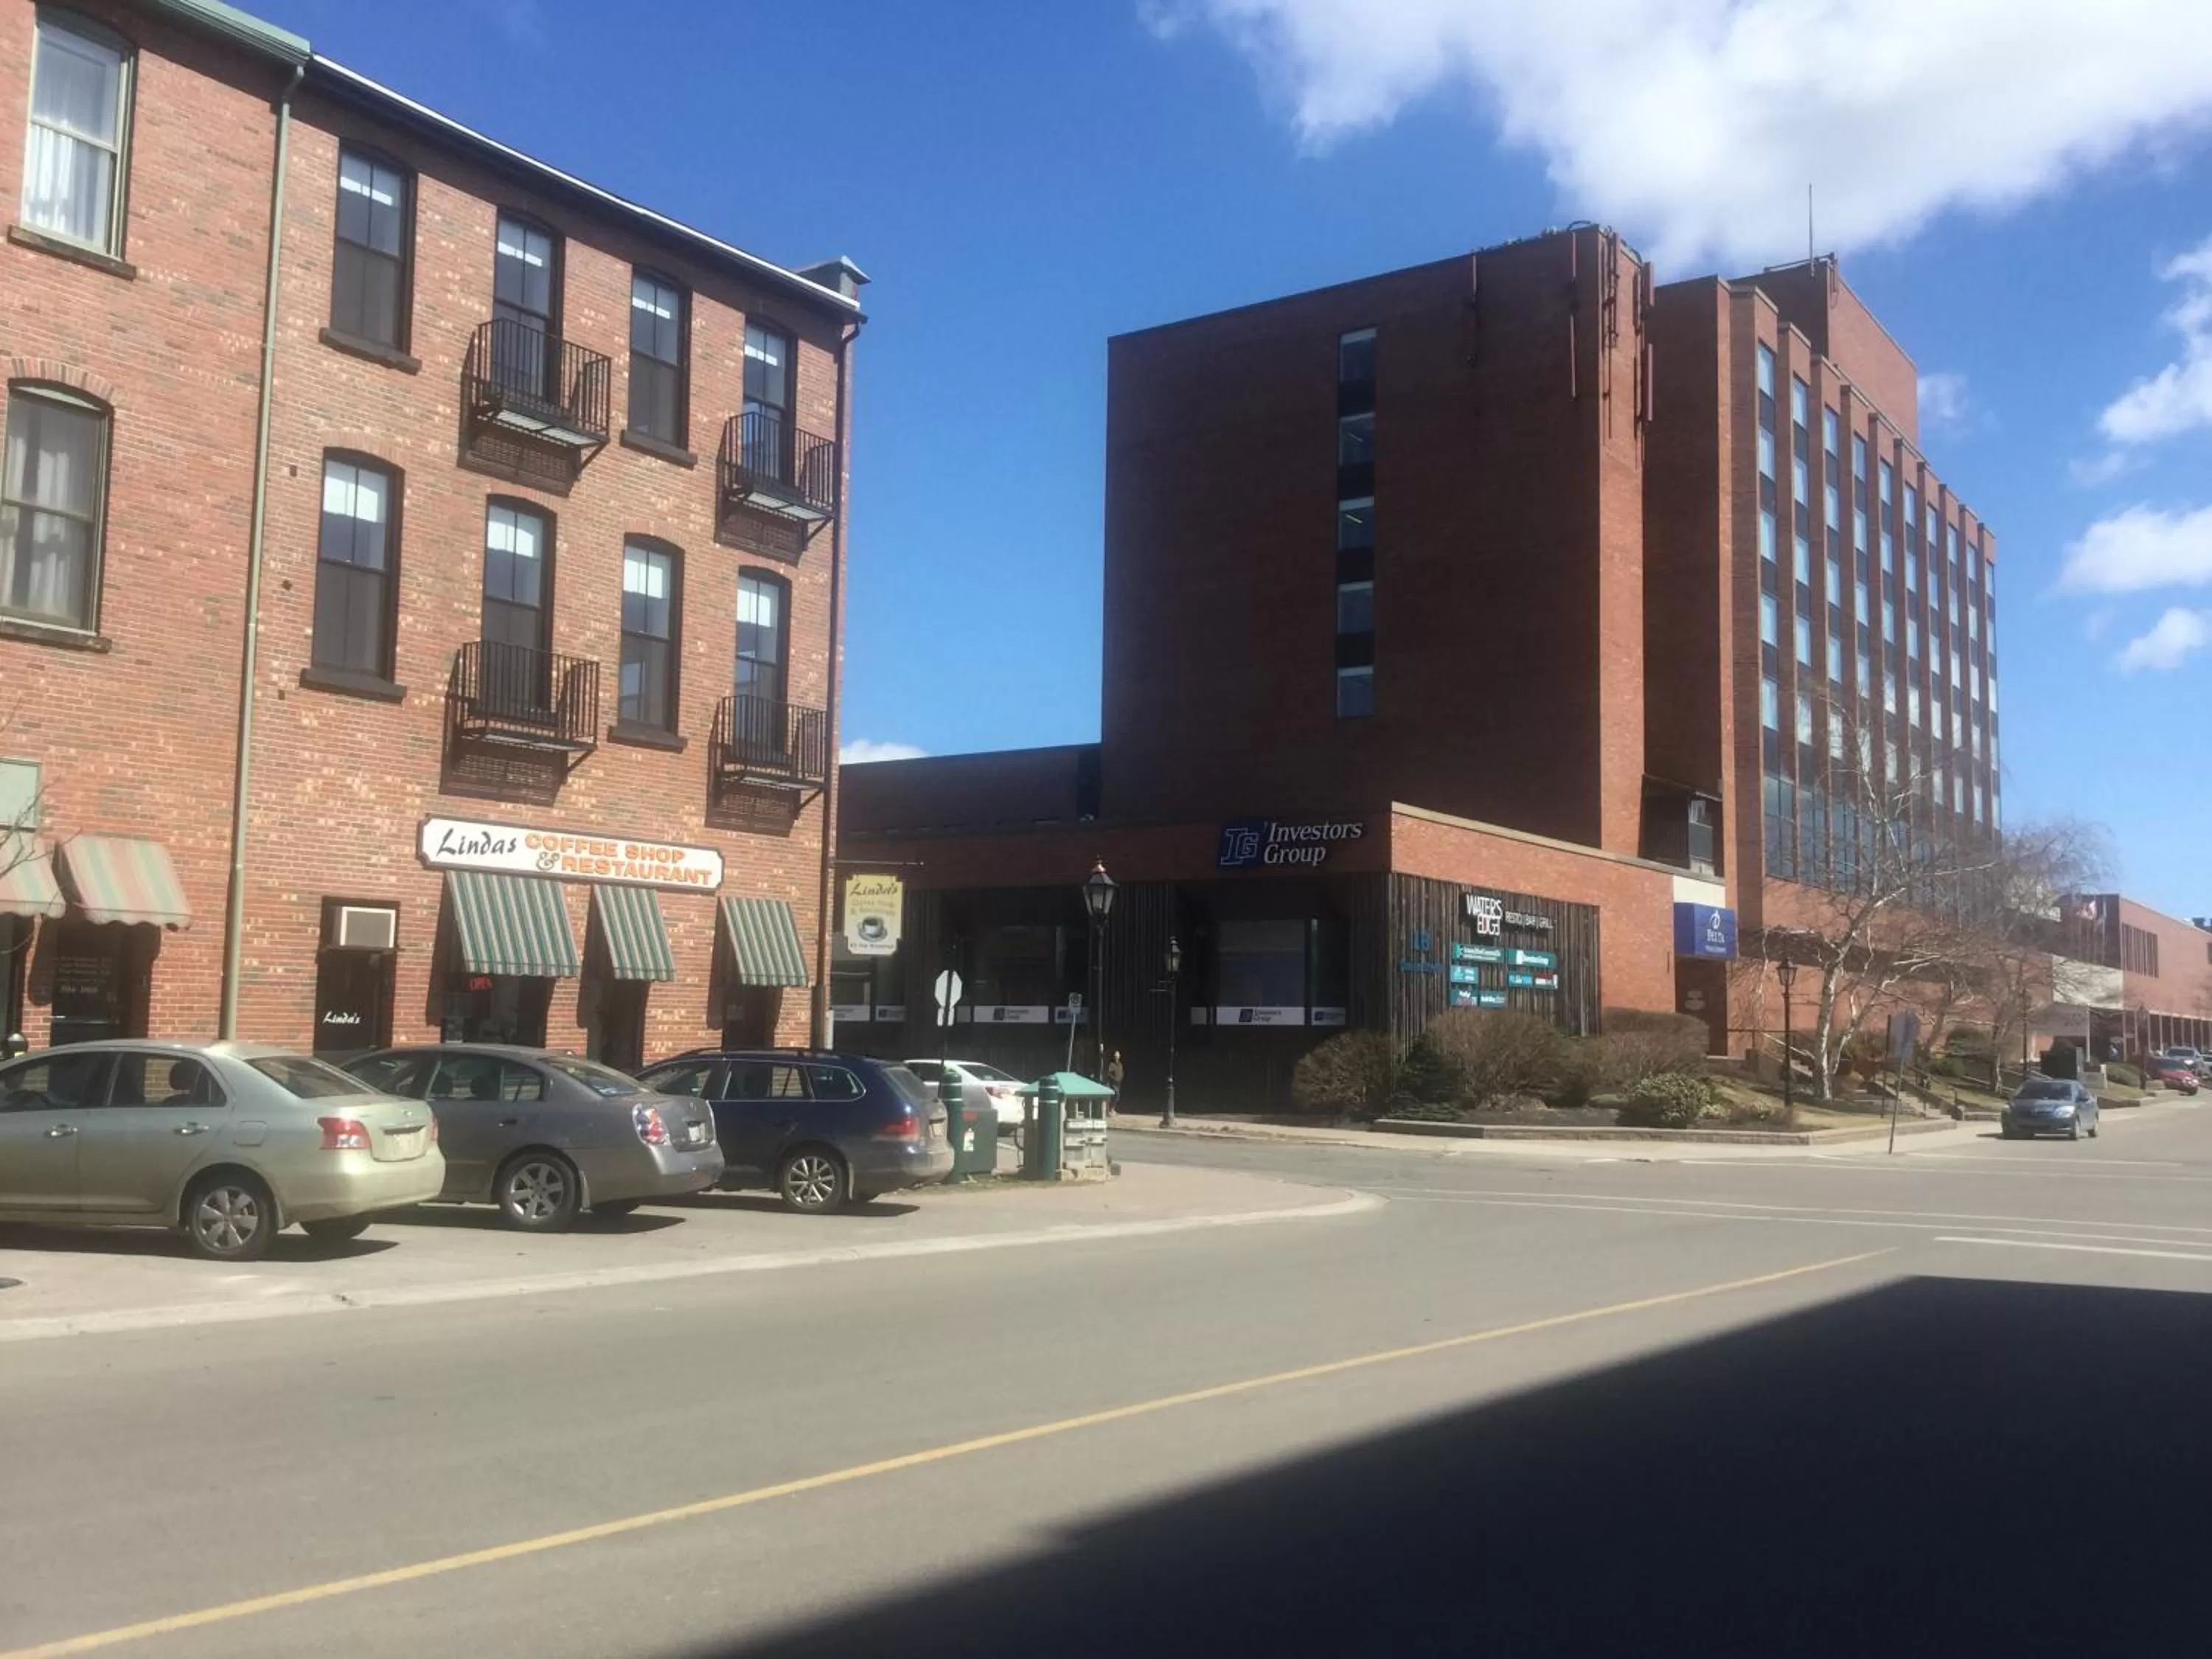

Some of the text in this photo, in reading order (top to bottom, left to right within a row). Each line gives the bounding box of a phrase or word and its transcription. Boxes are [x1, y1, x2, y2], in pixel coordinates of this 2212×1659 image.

[436, 828, 517, 858] Lindas
[1268, 821, 1363, 843] Investors
[525, 832, 686, 863] COFFEE SHOP
[1263, 844, 1326, 866] Group
[536, 852, 712, 886] & RESTAURANT
